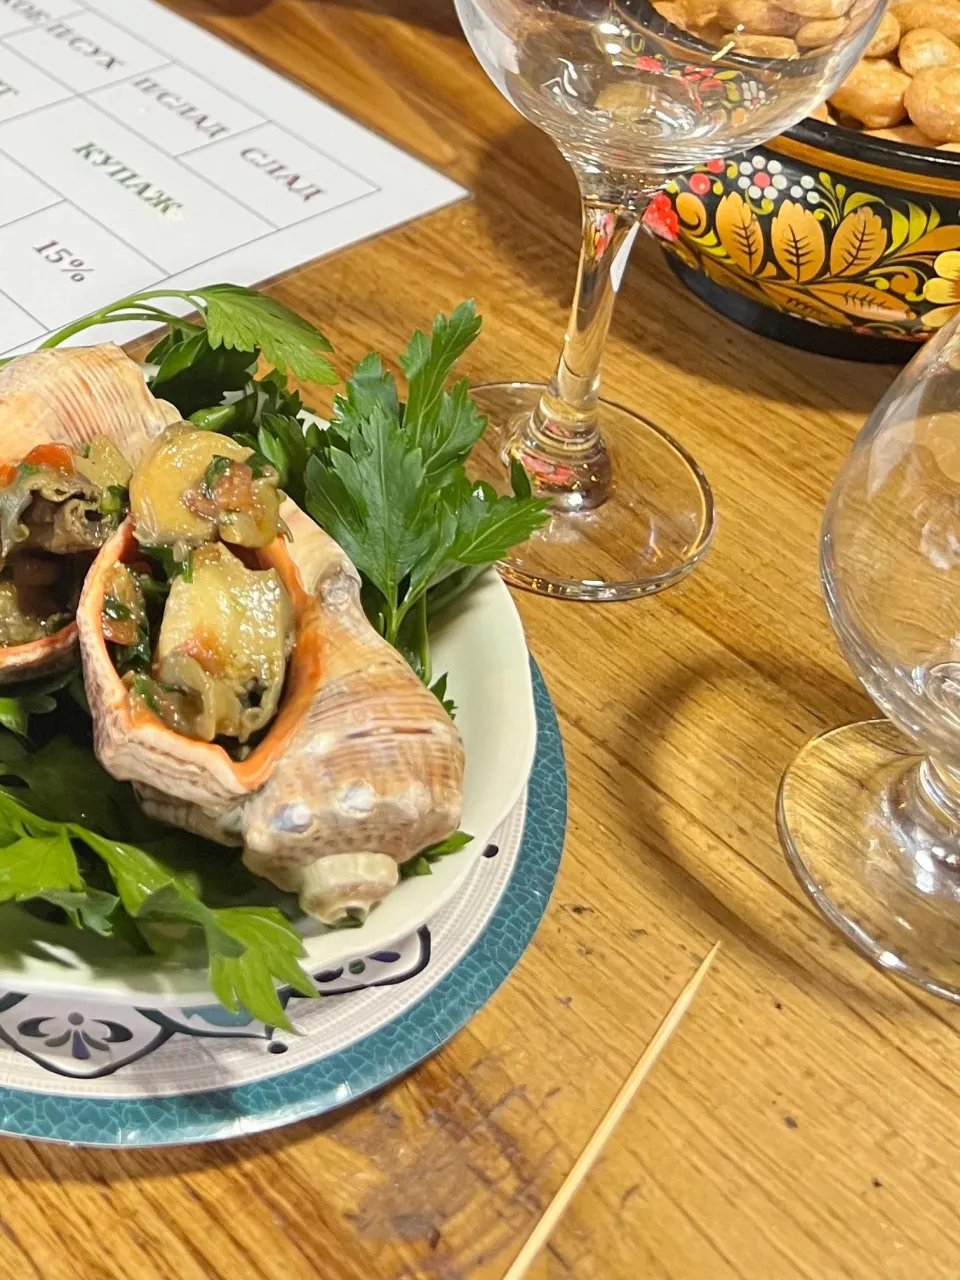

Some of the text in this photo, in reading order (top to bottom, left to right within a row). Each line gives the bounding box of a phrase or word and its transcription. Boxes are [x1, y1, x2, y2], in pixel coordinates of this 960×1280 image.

[72, 141, 184, 216] КУПАЖ
[240, 146, 328, 203] СЛАД
[34, 240, 95, 283] 15%
